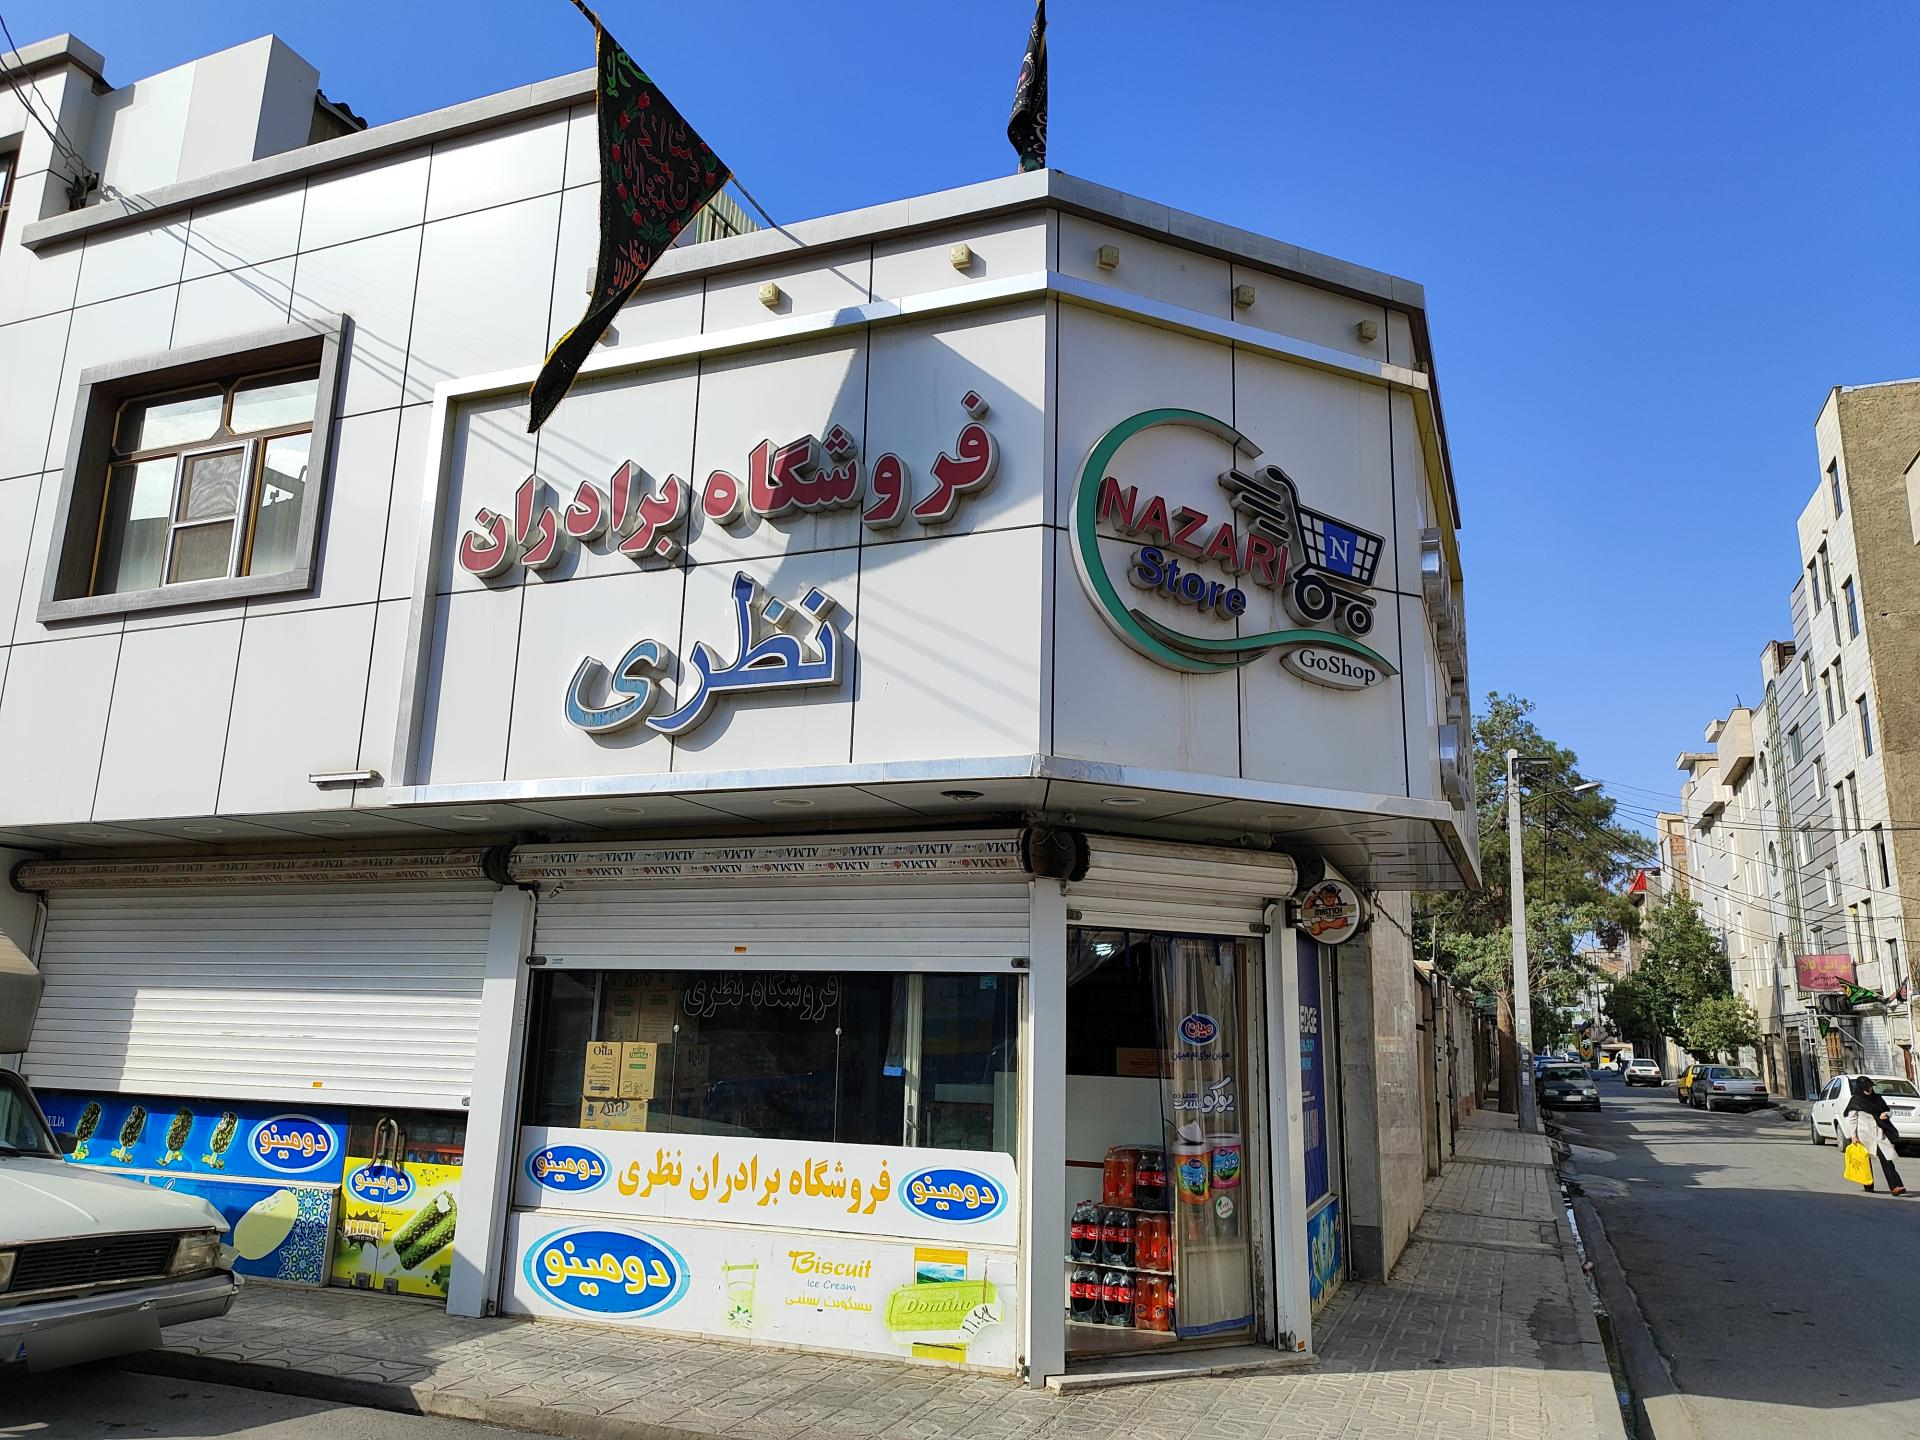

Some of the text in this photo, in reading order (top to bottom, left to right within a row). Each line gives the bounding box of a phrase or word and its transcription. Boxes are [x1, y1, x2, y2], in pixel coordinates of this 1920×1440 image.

[460, 389, 999, 578] فروشگاه برادران
[1097, 476, 1289, 588] NAZARI
[1329, 536, 1350, 563] N
[1128, 546, 1248, 621] Store
[564, 570, 843, 736] نظری
[1299, 649, 1376, 686] GoShop
[260, 1124, 328, 1159] دومینو
[354, 1170, 409, 1195] دومینو
[536, 1145, 604, 1180] دومینو
[616, 1149, 892, 1215] فروشگاه برادران نظری
[910, 1167, 997, 1210] دومینو
[543, 1240, 672, 1298] دومینو
[788, 1250, 872, 1278] Biscuit
[807, 1279, 858, 1292] Ice Cream
